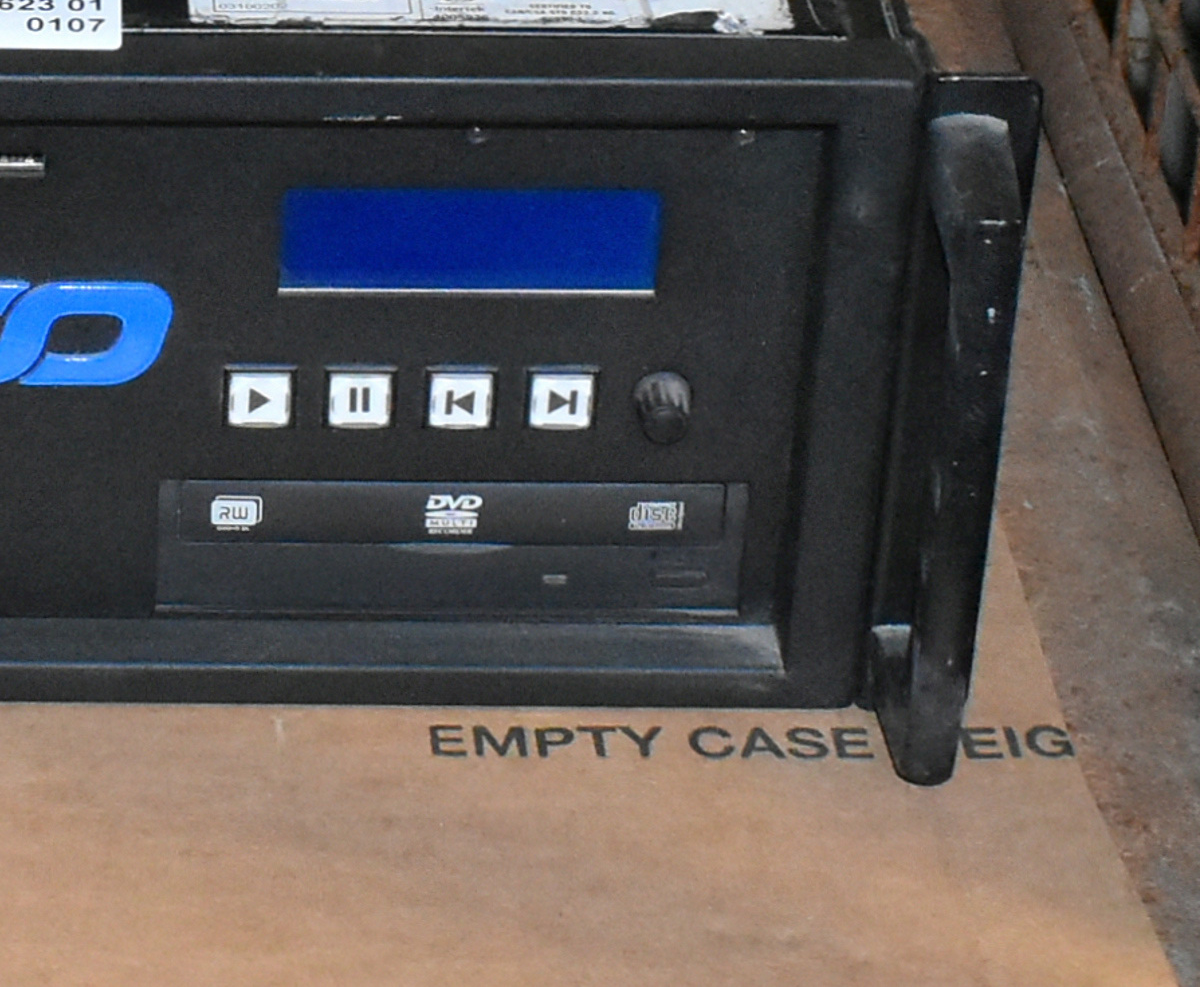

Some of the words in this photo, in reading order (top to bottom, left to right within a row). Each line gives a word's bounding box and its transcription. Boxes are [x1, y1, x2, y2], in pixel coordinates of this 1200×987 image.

[26, 17, 106, 32] 0107
[425, 494, 484, 510] DVD
[219, 506, 249, 520] RW
[428, 724, 664, 759] EMPTY
[687, 725, 877, 760] CASE
[959, 724, 1076, 760] EIG
